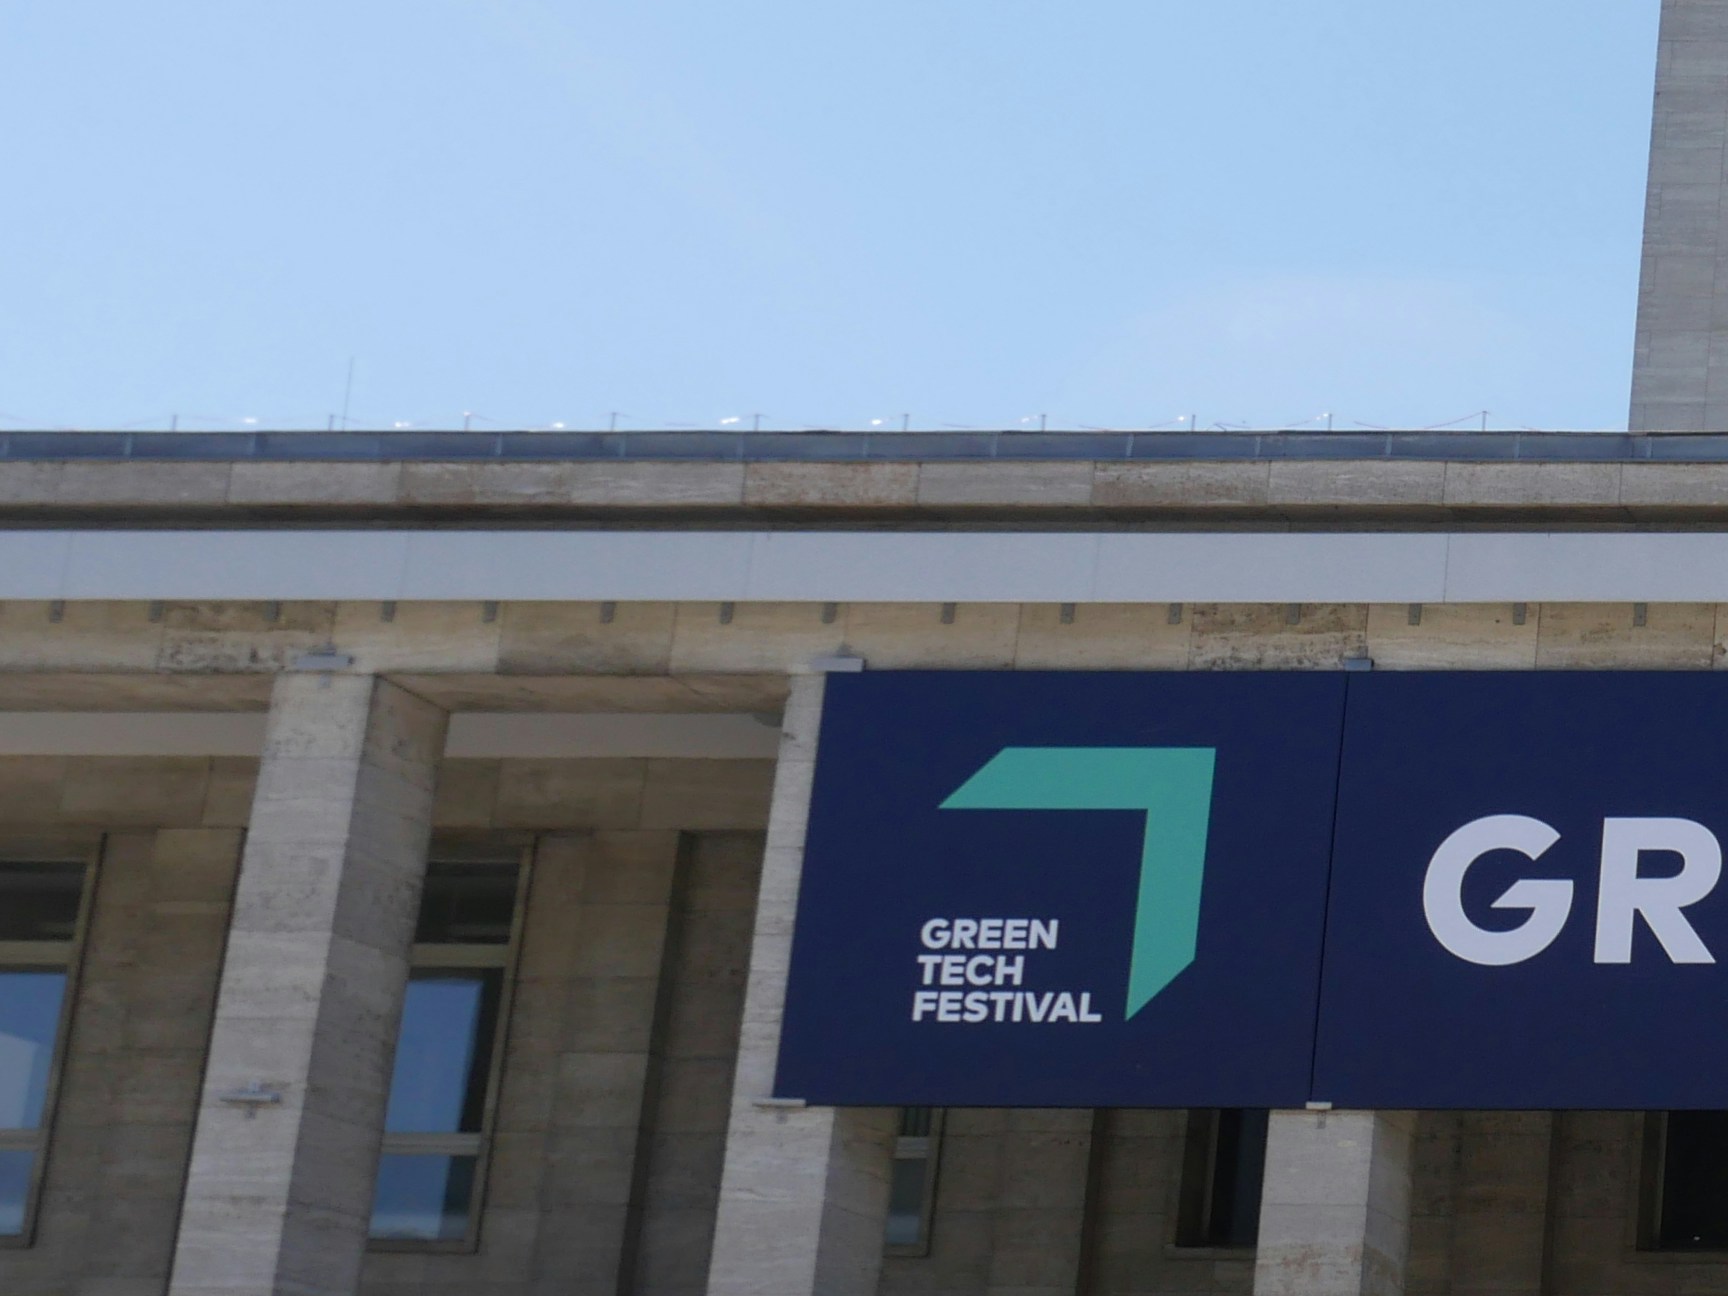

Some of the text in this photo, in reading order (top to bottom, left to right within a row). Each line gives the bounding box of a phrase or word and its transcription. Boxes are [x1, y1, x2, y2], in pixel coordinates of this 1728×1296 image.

[920, 918, 1059, 949] GREEN
[917, 955, 1025, 986] TECH
[912, 991, 1102, 1022] FESTIVAL
